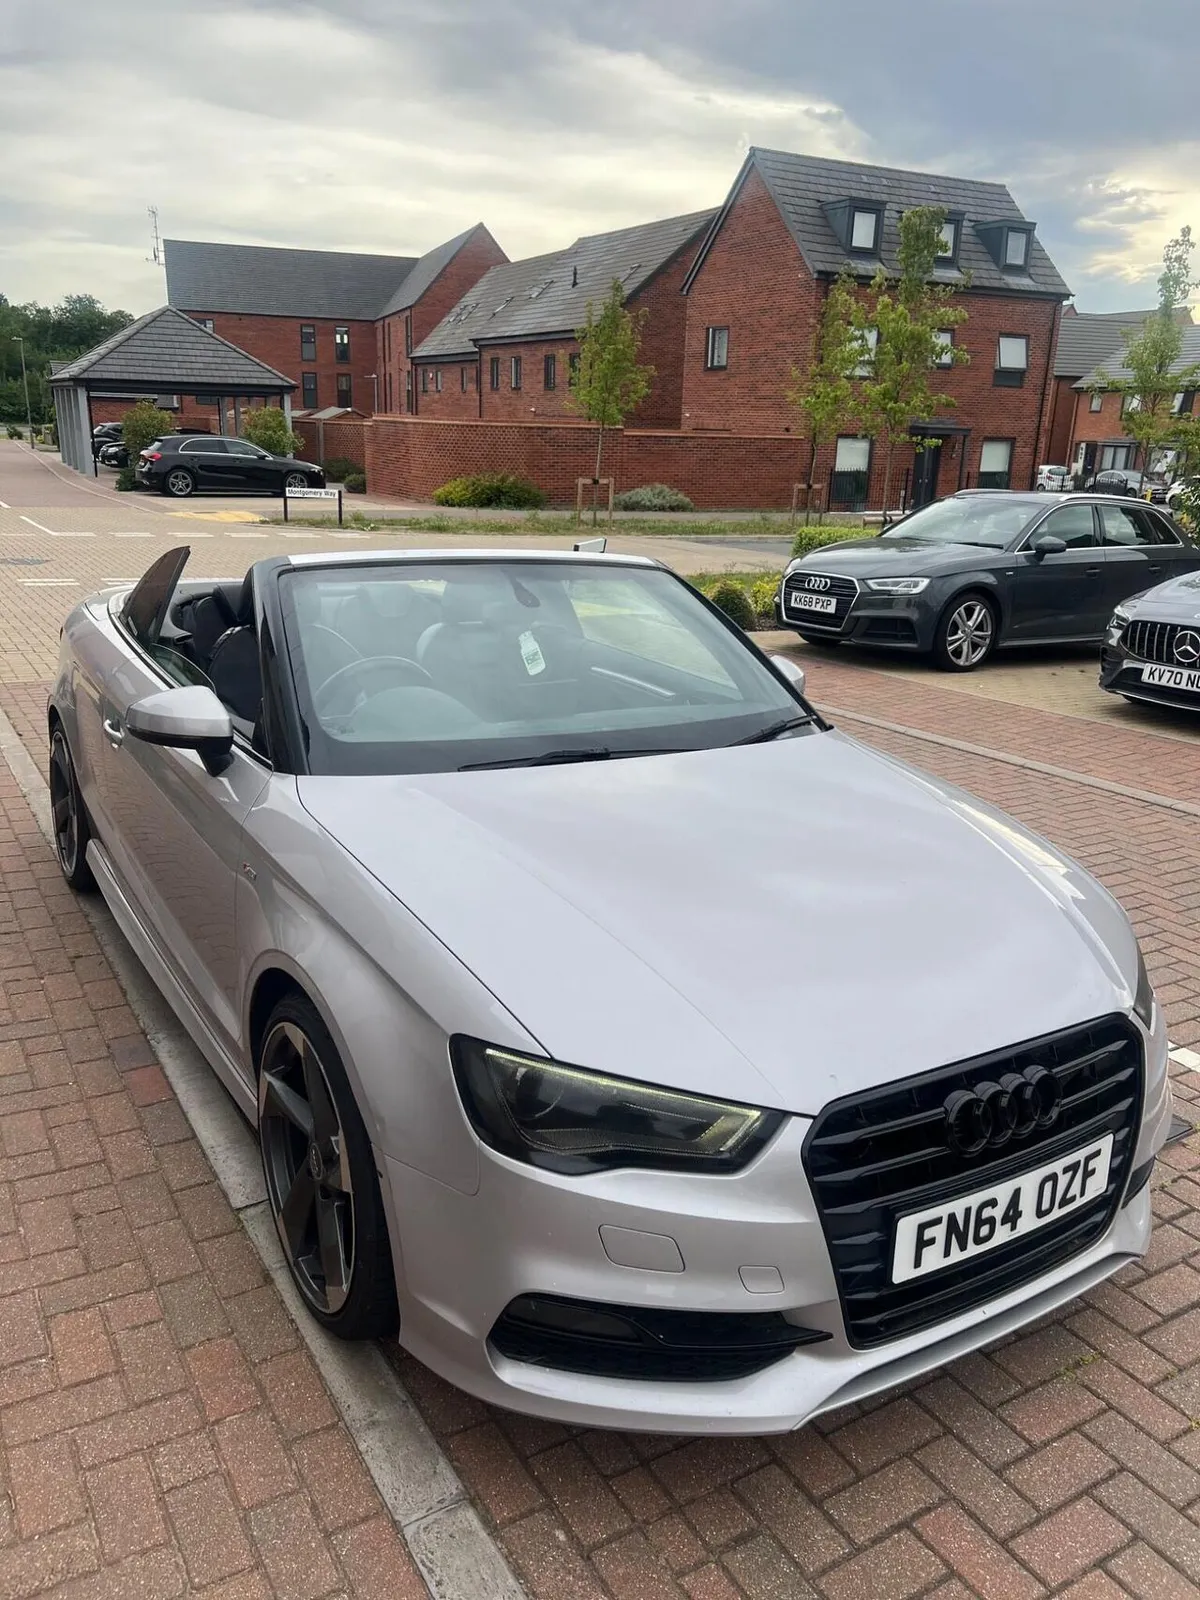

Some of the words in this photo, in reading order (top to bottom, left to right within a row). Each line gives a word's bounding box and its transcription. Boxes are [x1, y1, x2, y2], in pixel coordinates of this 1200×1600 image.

[287, 488, 322, 497] Montgomery
[323, 490, 337, 498] Way
[793, 594, 814, 608] KK68
[814, 597, 832, 610] PXP
[1147, 666, 1184, 686] KV70
[913, 1187, 1023, 1270] FN64
[1035, 1148, 1102, 1220] OZF
